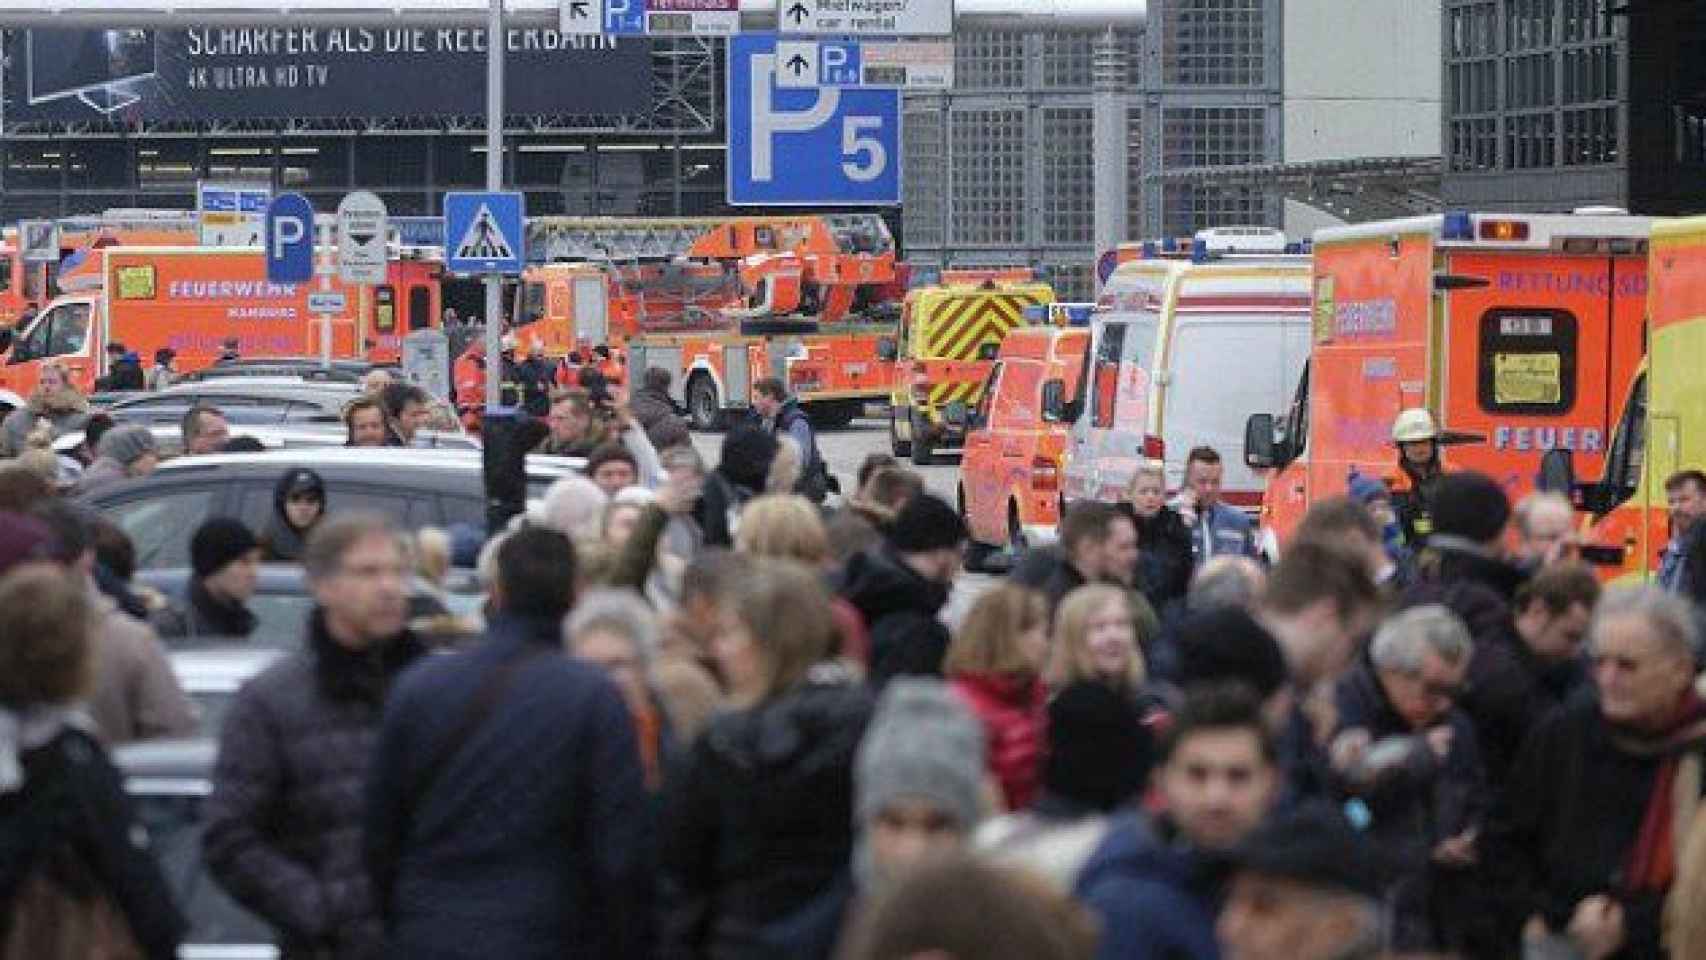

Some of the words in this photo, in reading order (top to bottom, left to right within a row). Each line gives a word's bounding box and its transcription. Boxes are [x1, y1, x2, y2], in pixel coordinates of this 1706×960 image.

[816, 18, 842, 27] car
[851, 15, 896, 29] rental
[327, 28, 374, 53] ALS
[384, 28, 426, 52] DIE
[213, 66, 267, 90] ULTRA
[274, 65, 298, 88] HD
[306, 64, 328, 87] TV
[824, 48, 847, 81] P
[752, 55, 839, 181] P
[841, 115, 887, 182] 5
[273, 215, 304, 259] P
[227, 307, 297, 319] HAMBURG
[1495, 425, 1603, 451] FEUER
